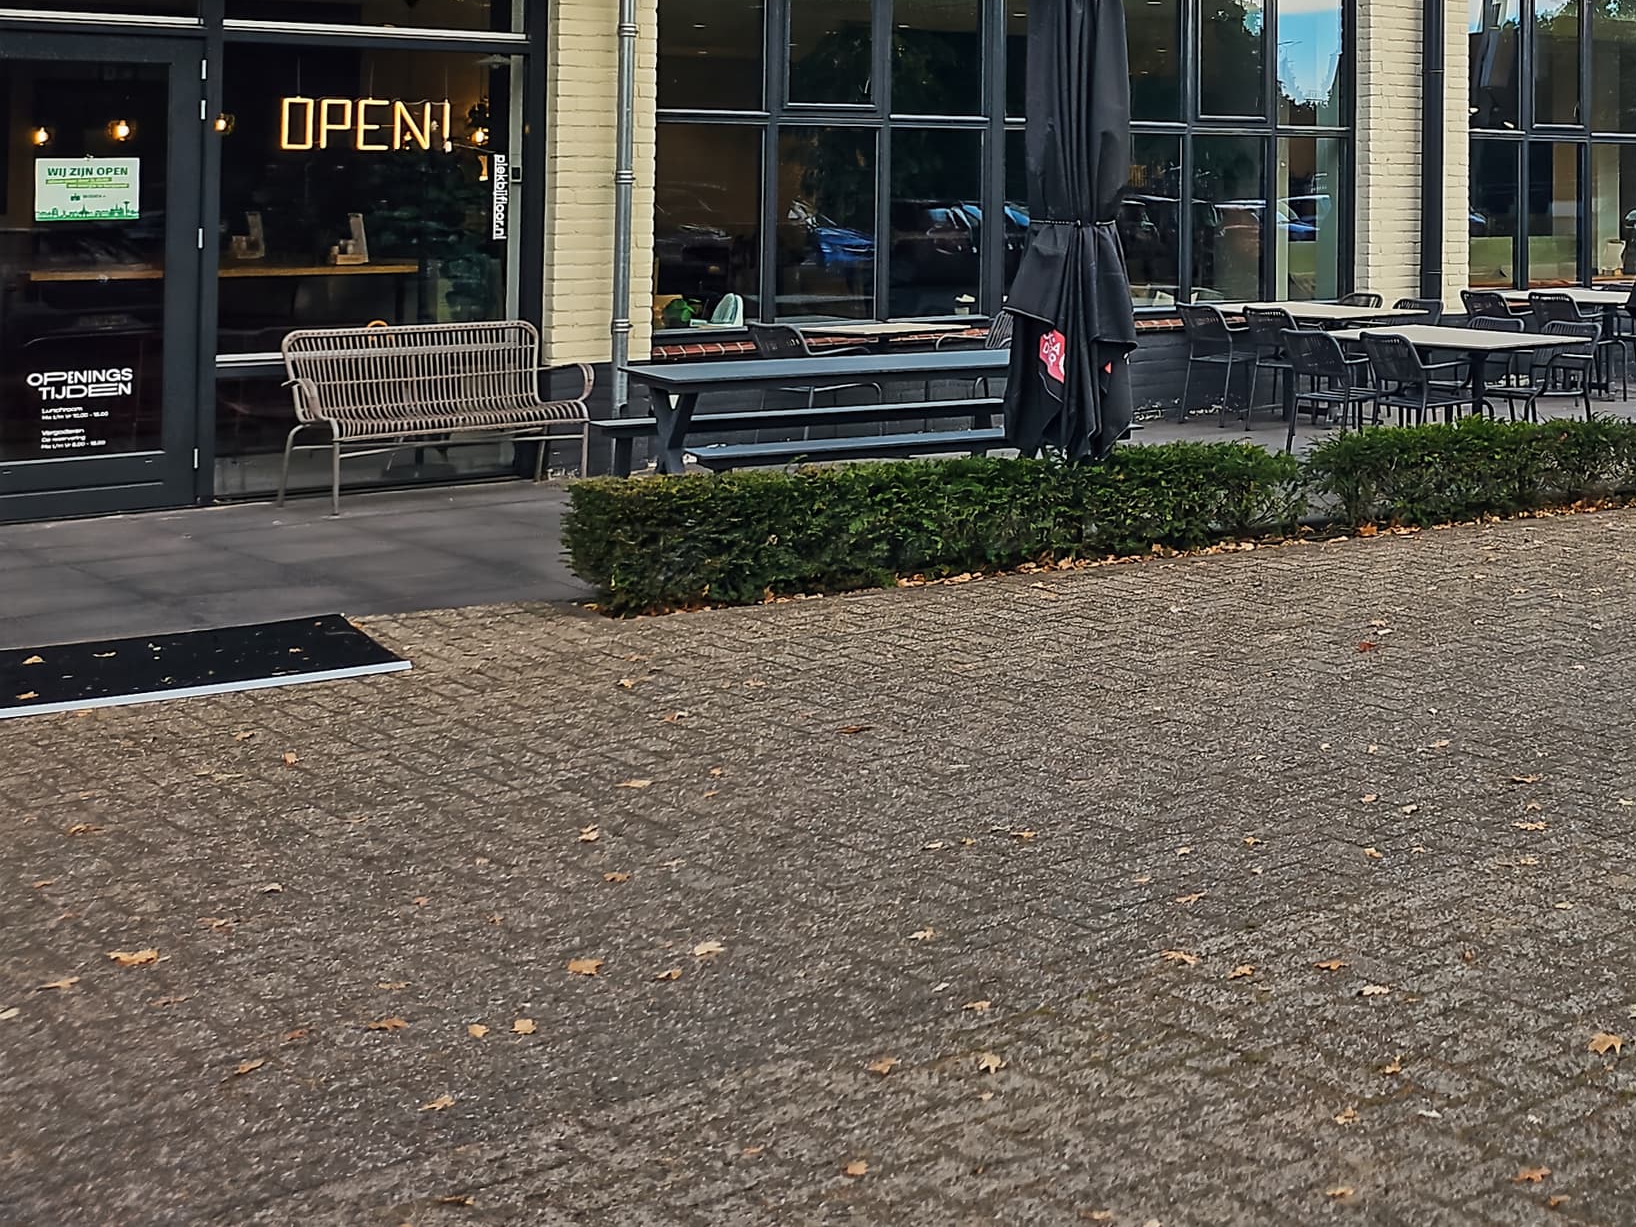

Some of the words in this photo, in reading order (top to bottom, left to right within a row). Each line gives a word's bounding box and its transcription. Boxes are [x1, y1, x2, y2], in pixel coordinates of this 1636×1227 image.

[281, 96, 452, 152] OPEN!
[47, 167, 67, 178] WIJ
[69, 167, 94, 178] ZIJN
[97, 167, 128, 176] OPEN
[26, 368, 133, 387] OPENINGS
[38, 382, 132, 401] TIJDEN
[41, 406, 83, 415] Lunchroom
